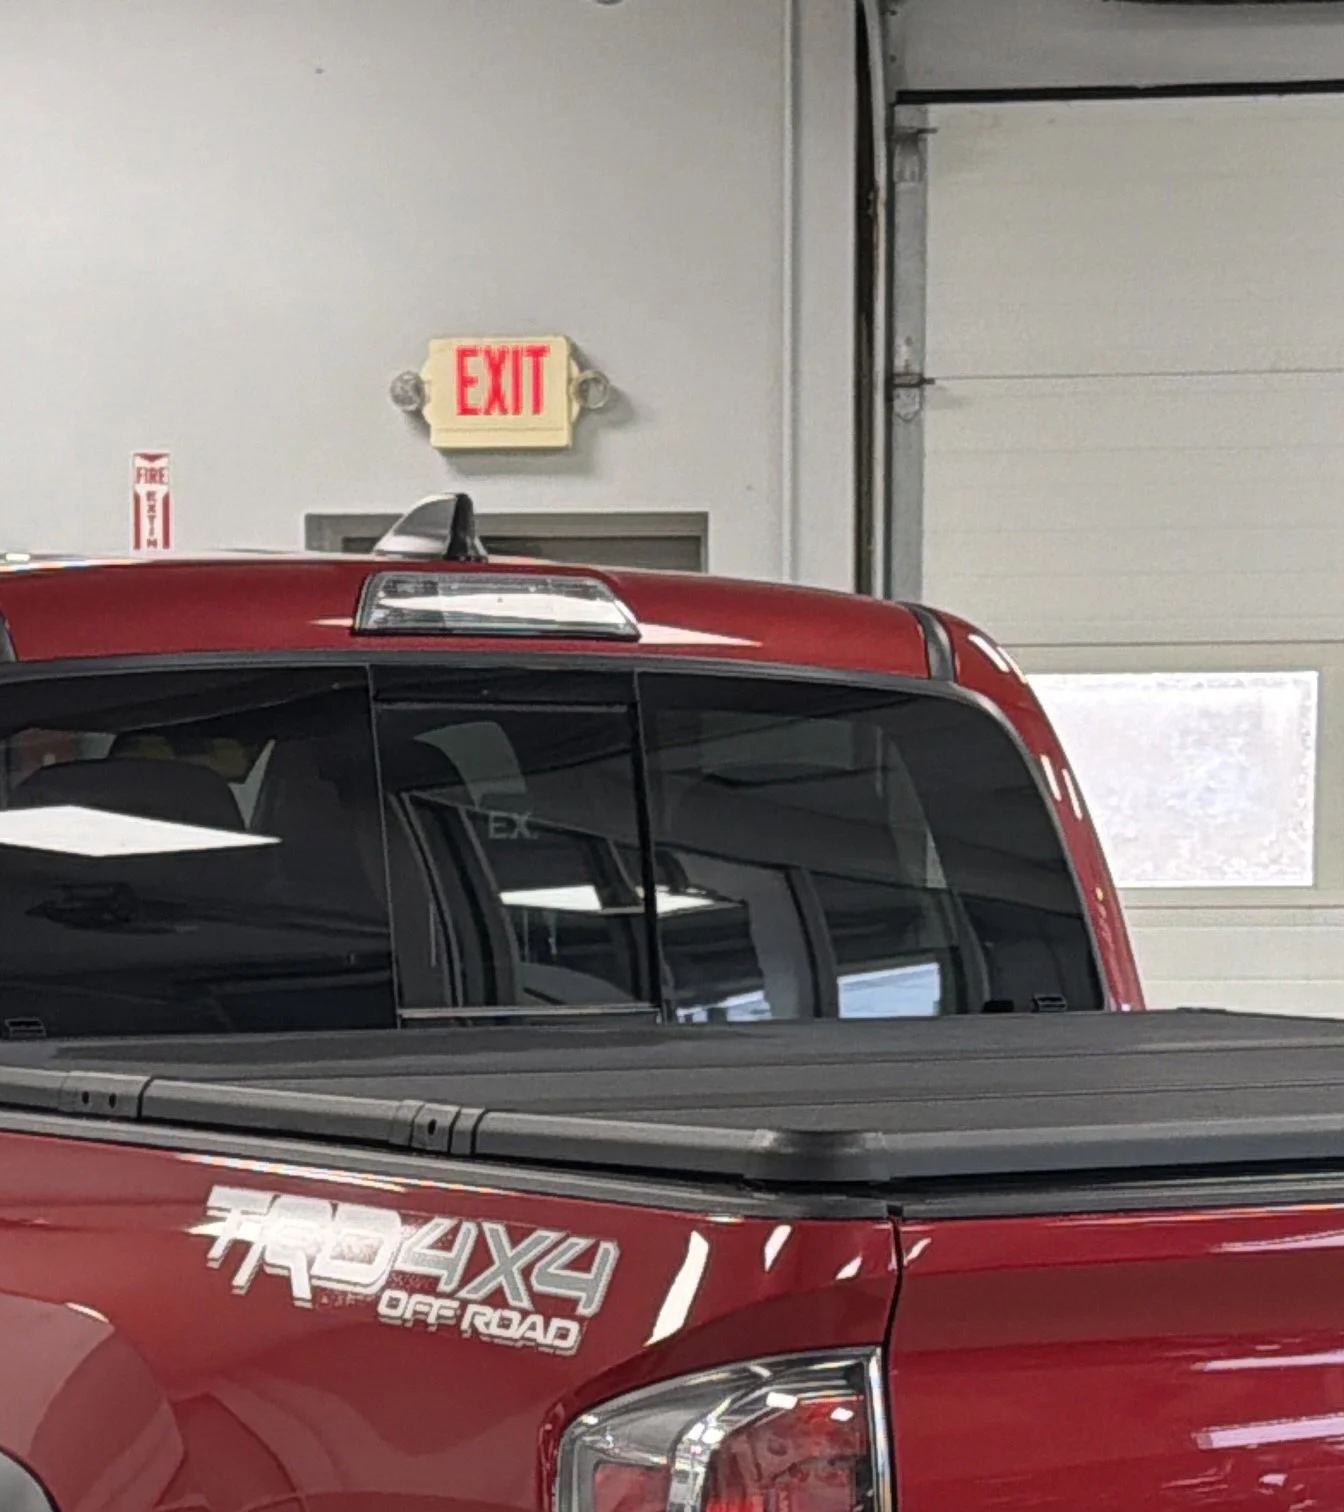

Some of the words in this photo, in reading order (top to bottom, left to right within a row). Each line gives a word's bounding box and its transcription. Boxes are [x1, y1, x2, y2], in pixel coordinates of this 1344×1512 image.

[455, 344, 550, 416] EXIT
[136, 466, 169, 484] FIRE
[377, 1290, 459, 1331] OFF
[460, 1303, 584, 1356] ROAD
